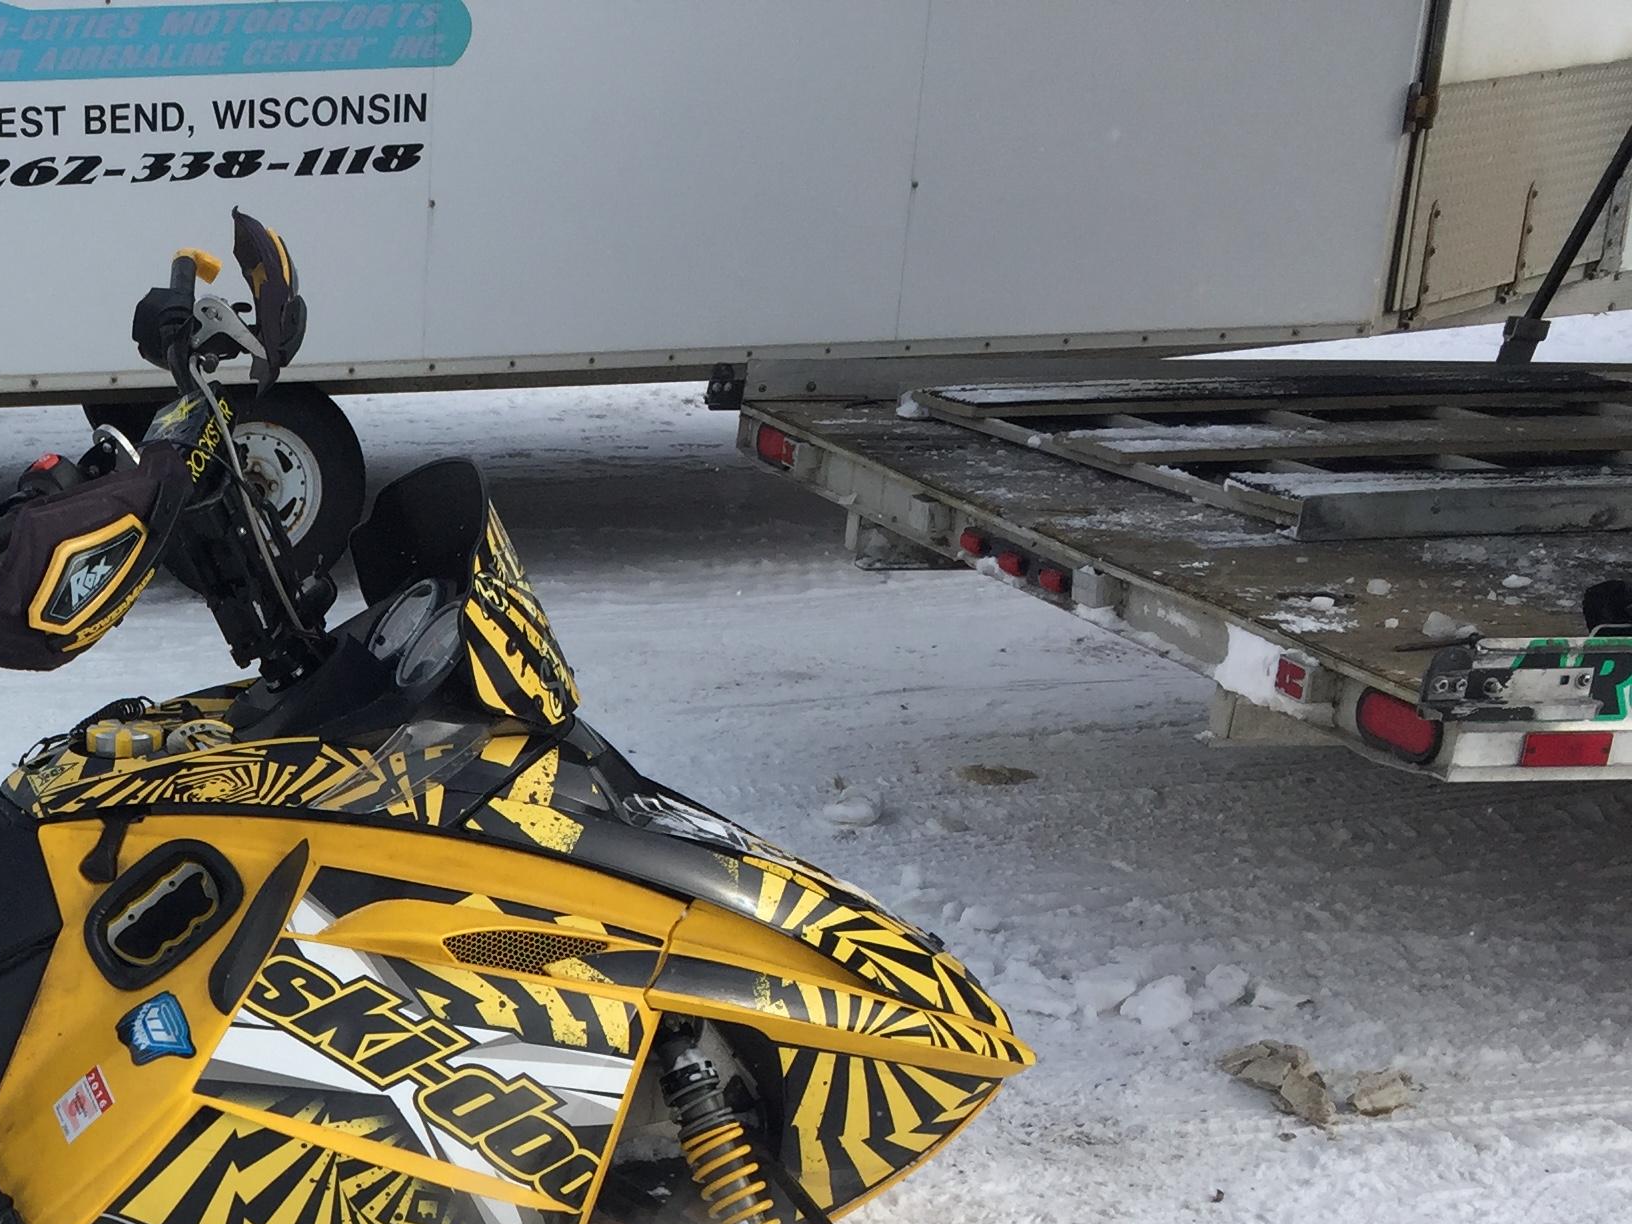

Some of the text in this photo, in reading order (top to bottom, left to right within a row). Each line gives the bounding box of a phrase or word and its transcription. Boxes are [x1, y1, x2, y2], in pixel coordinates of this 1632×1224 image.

[158, 3, 442, 38] MOTORSPORTS
[34, 41, 230, 73] ADRENALINE
[84, 102, 195, 138] BEND,
[213, 93, 427, 130] WISCONSIN
[87, 1072, 108, 1109] 2016
